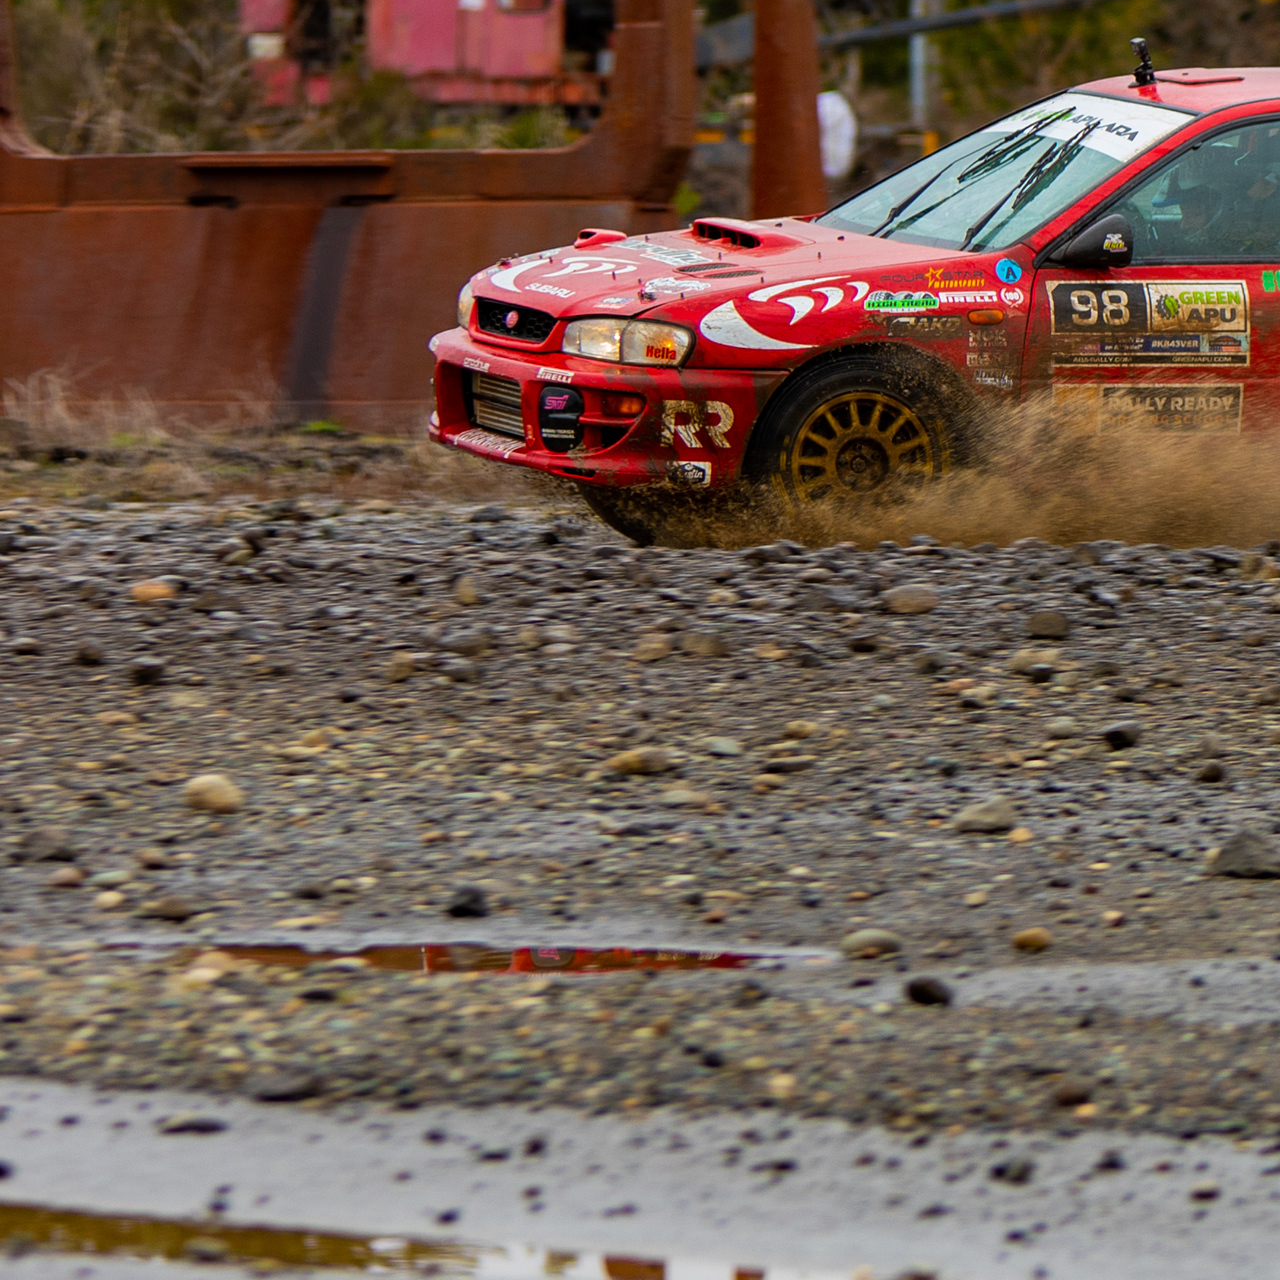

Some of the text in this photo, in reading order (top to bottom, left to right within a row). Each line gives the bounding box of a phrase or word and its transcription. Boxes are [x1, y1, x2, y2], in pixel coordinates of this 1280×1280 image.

[880, 271, 984, 283] FOUR STAR
[934, 279, 985, 288] MOTORSPORTS
[524, 282, 576, 299] SUBARU
[939, 291, 997, 303] PIRELLI
[1179, 291, 1241, 305] GREEN
[1070, 290, 1130, 326] 98
[1187, 308, 1236, 323] APU
[645, 345, 677, 360] Hella
[1171, 396, 1234, 411] READY
